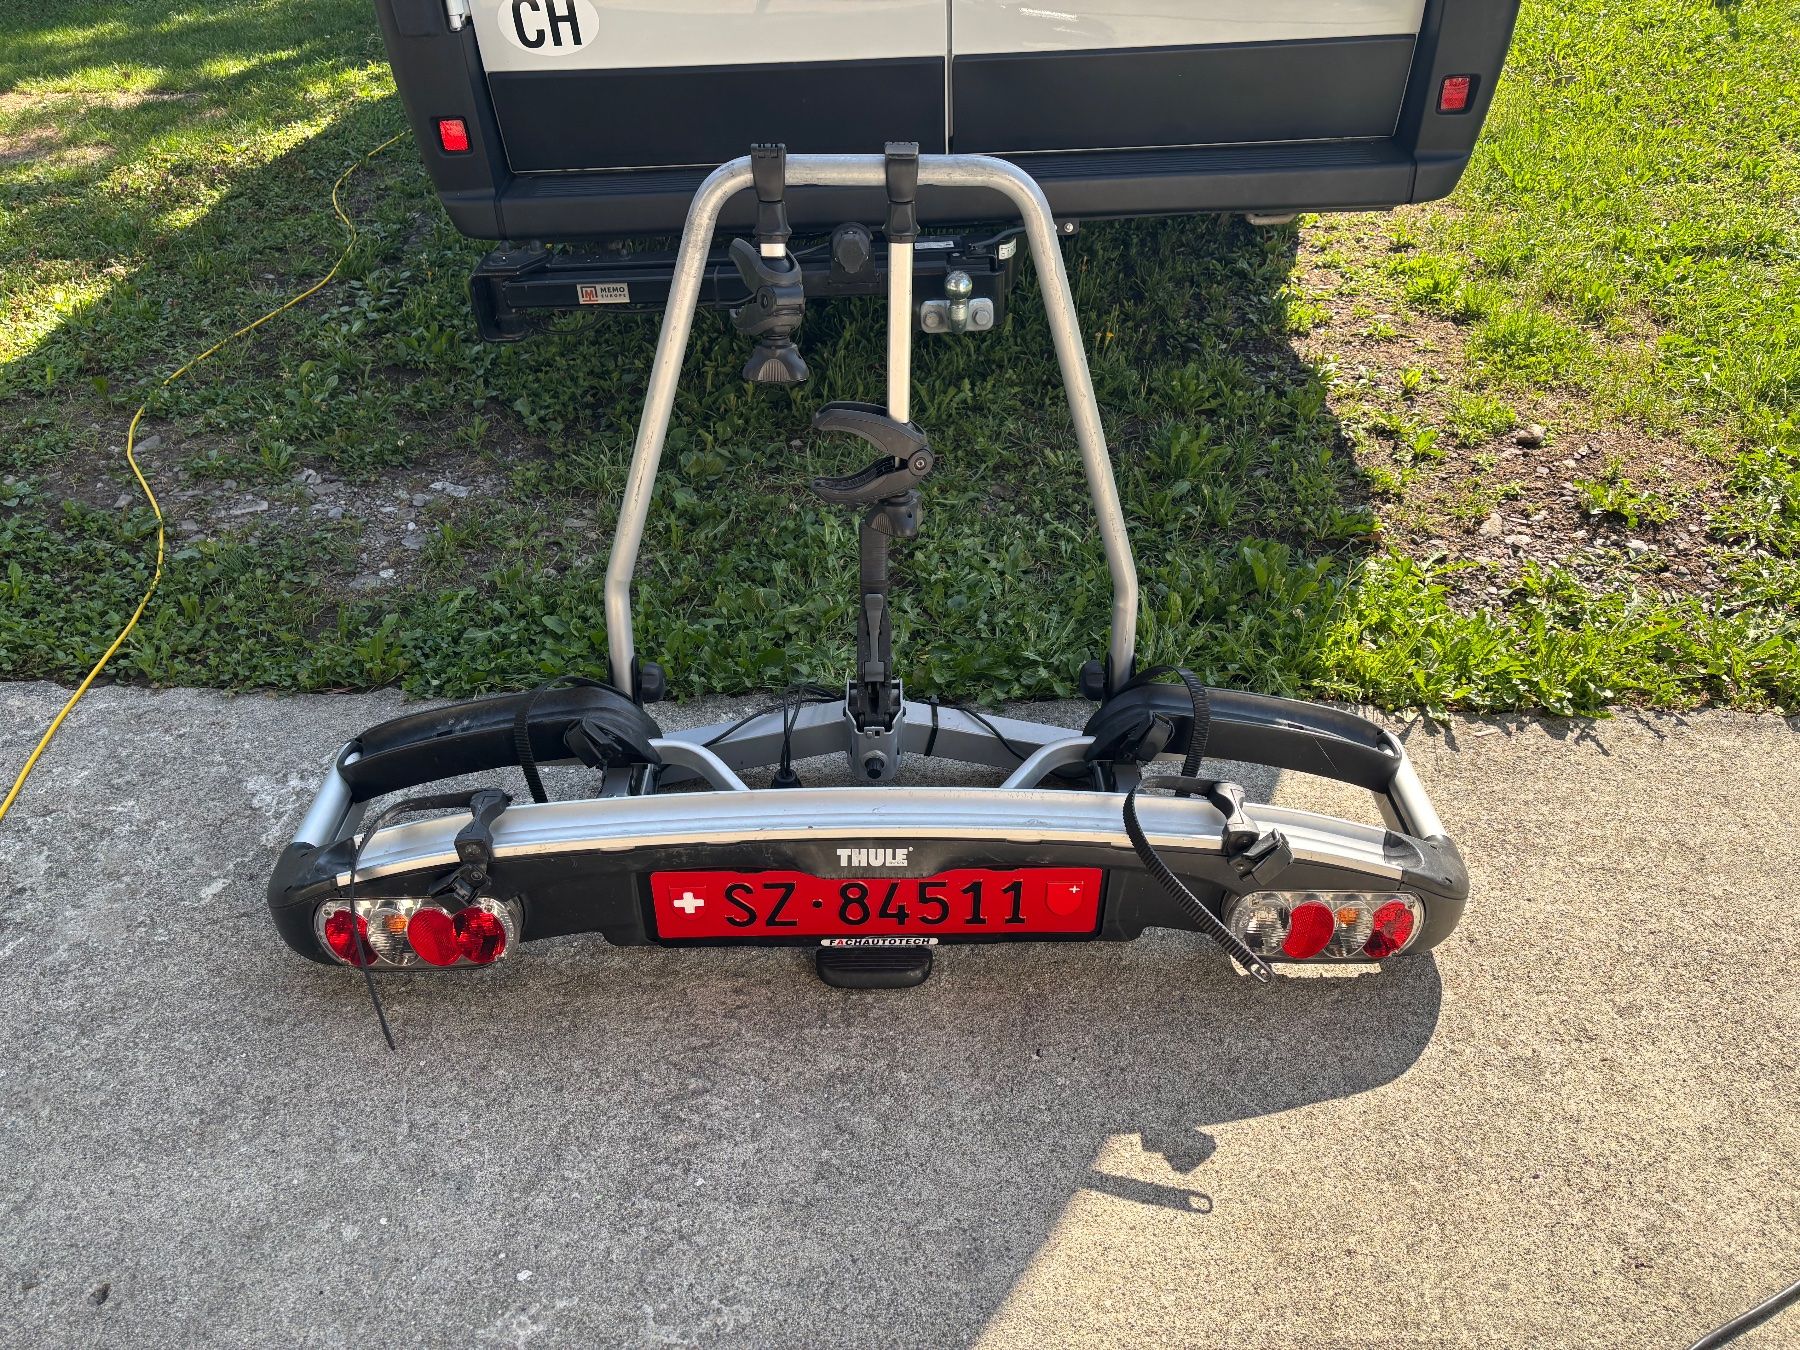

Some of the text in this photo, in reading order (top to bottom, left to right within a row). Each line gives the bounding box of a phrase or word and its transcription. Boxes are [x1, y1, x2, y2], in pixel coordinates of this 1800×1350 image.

[512, 0, 582, 48] CH
[836, 848, 908, 867] THULE
[829, 938, 931, 946] FACHAUTOTECH
